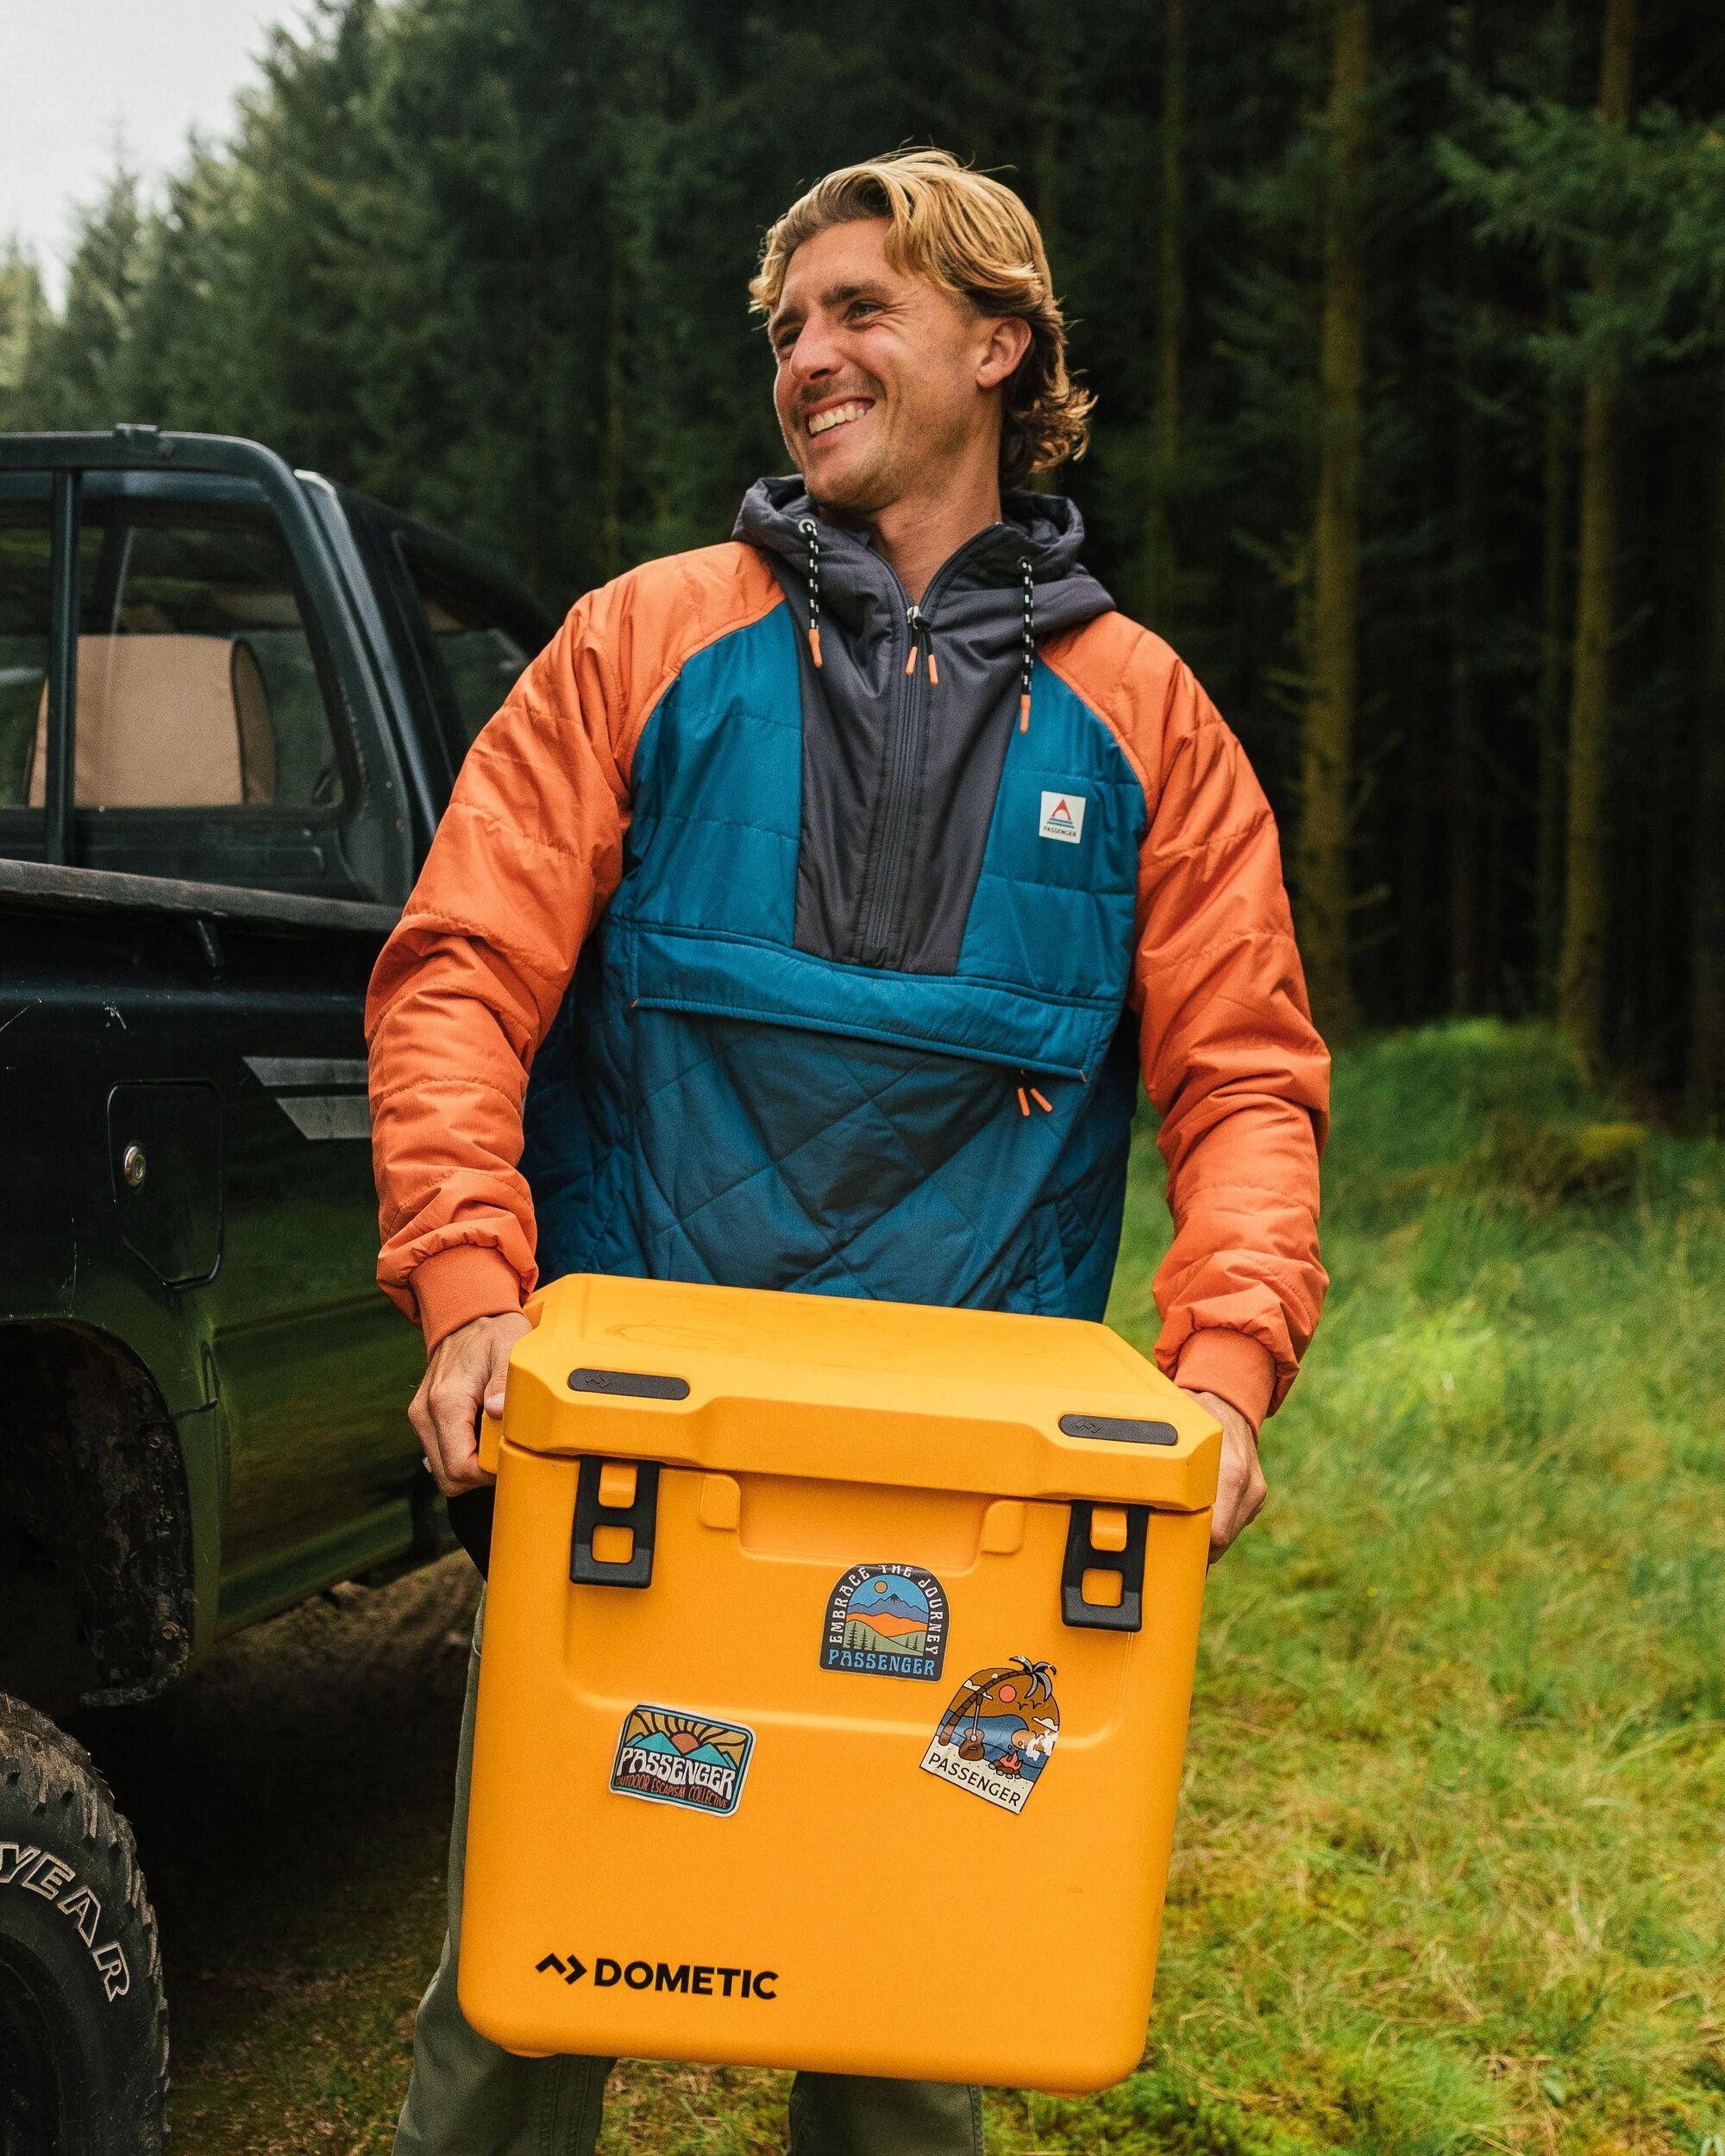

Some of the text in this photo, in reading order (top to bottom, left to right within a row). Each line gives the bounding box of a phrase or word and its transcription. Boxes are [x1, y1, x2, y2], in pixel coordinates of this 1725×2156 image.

[830, 1564, 944, 1655] EMBRACE THE JOURNEY
[828, 1649, 936, 1677] PASSENGER
[616, 1774, 728, 1808] OUTDOOR ESCAPISM COLLECTIVE
[617, 1747, 736, 1801] PASSENGER
[928, 1752, 1021, 1807] PASSENGER
[594, 1958, 779, 2000] DOMETIC
